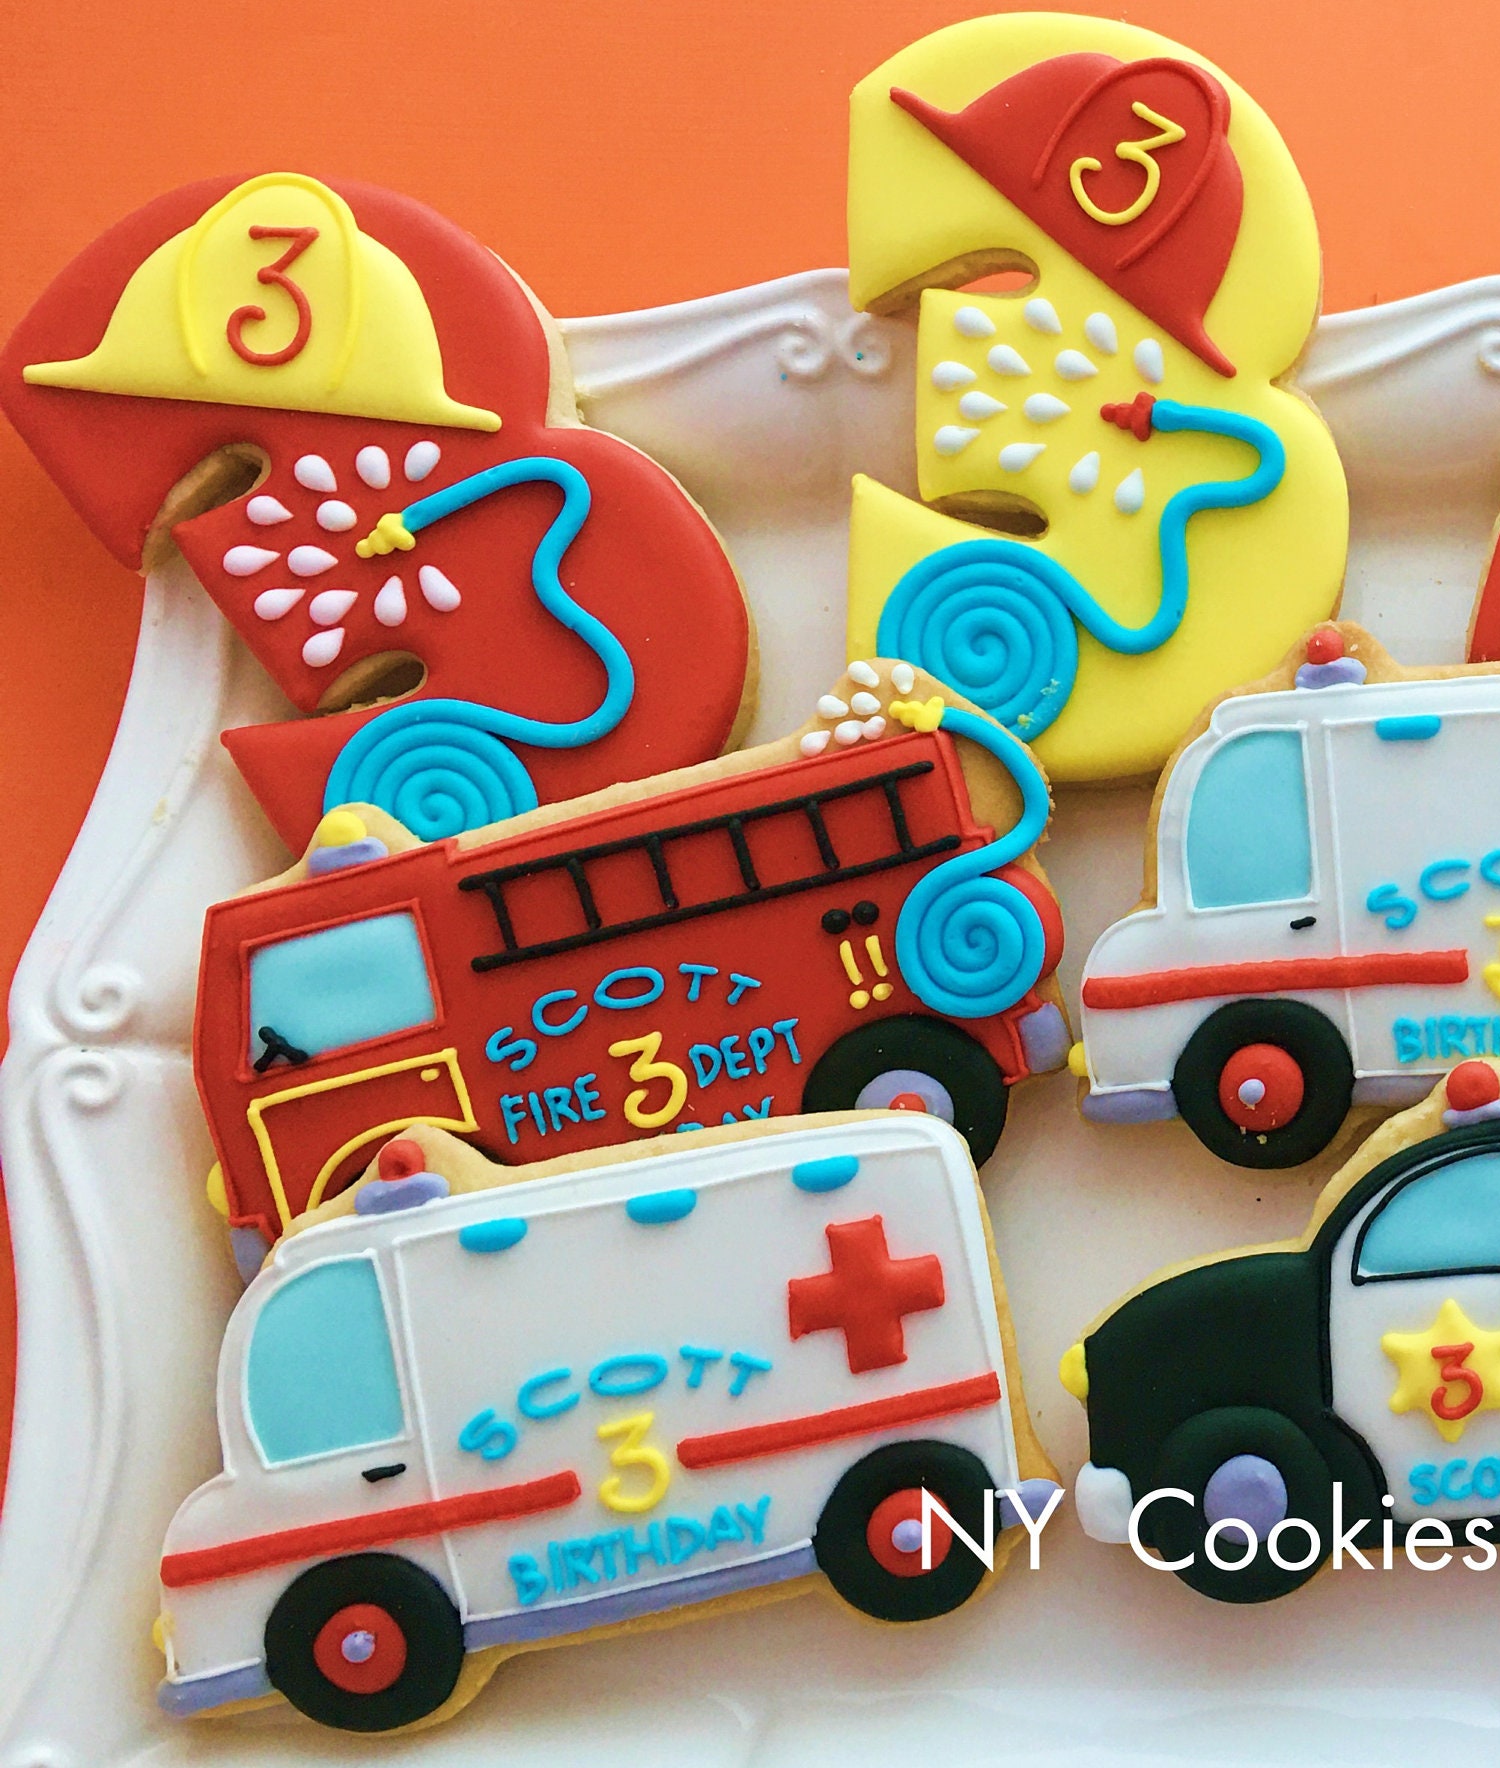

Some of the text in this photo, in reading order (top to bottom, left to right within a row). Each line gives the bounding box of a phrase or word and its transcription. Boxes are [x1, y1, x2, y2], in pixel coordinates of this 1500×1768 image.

[1069, 100, 1186, 226] 3
[225, 225, 320, 367] 3
[485, 963, 762, 1072] SCOTT
[500, 1073, 606, 1144] FIRE
[608, 1031, 688, 1129] 3
[688, 1018, 802, 1088] DEPT
[458, 1345, 772, 1461] SCOTT
[1430, 1342, 1484, 1421] 3
[597, 1411, 672, 1513] 3
[508, 1494, 772, 1605] BIRTHDAY
